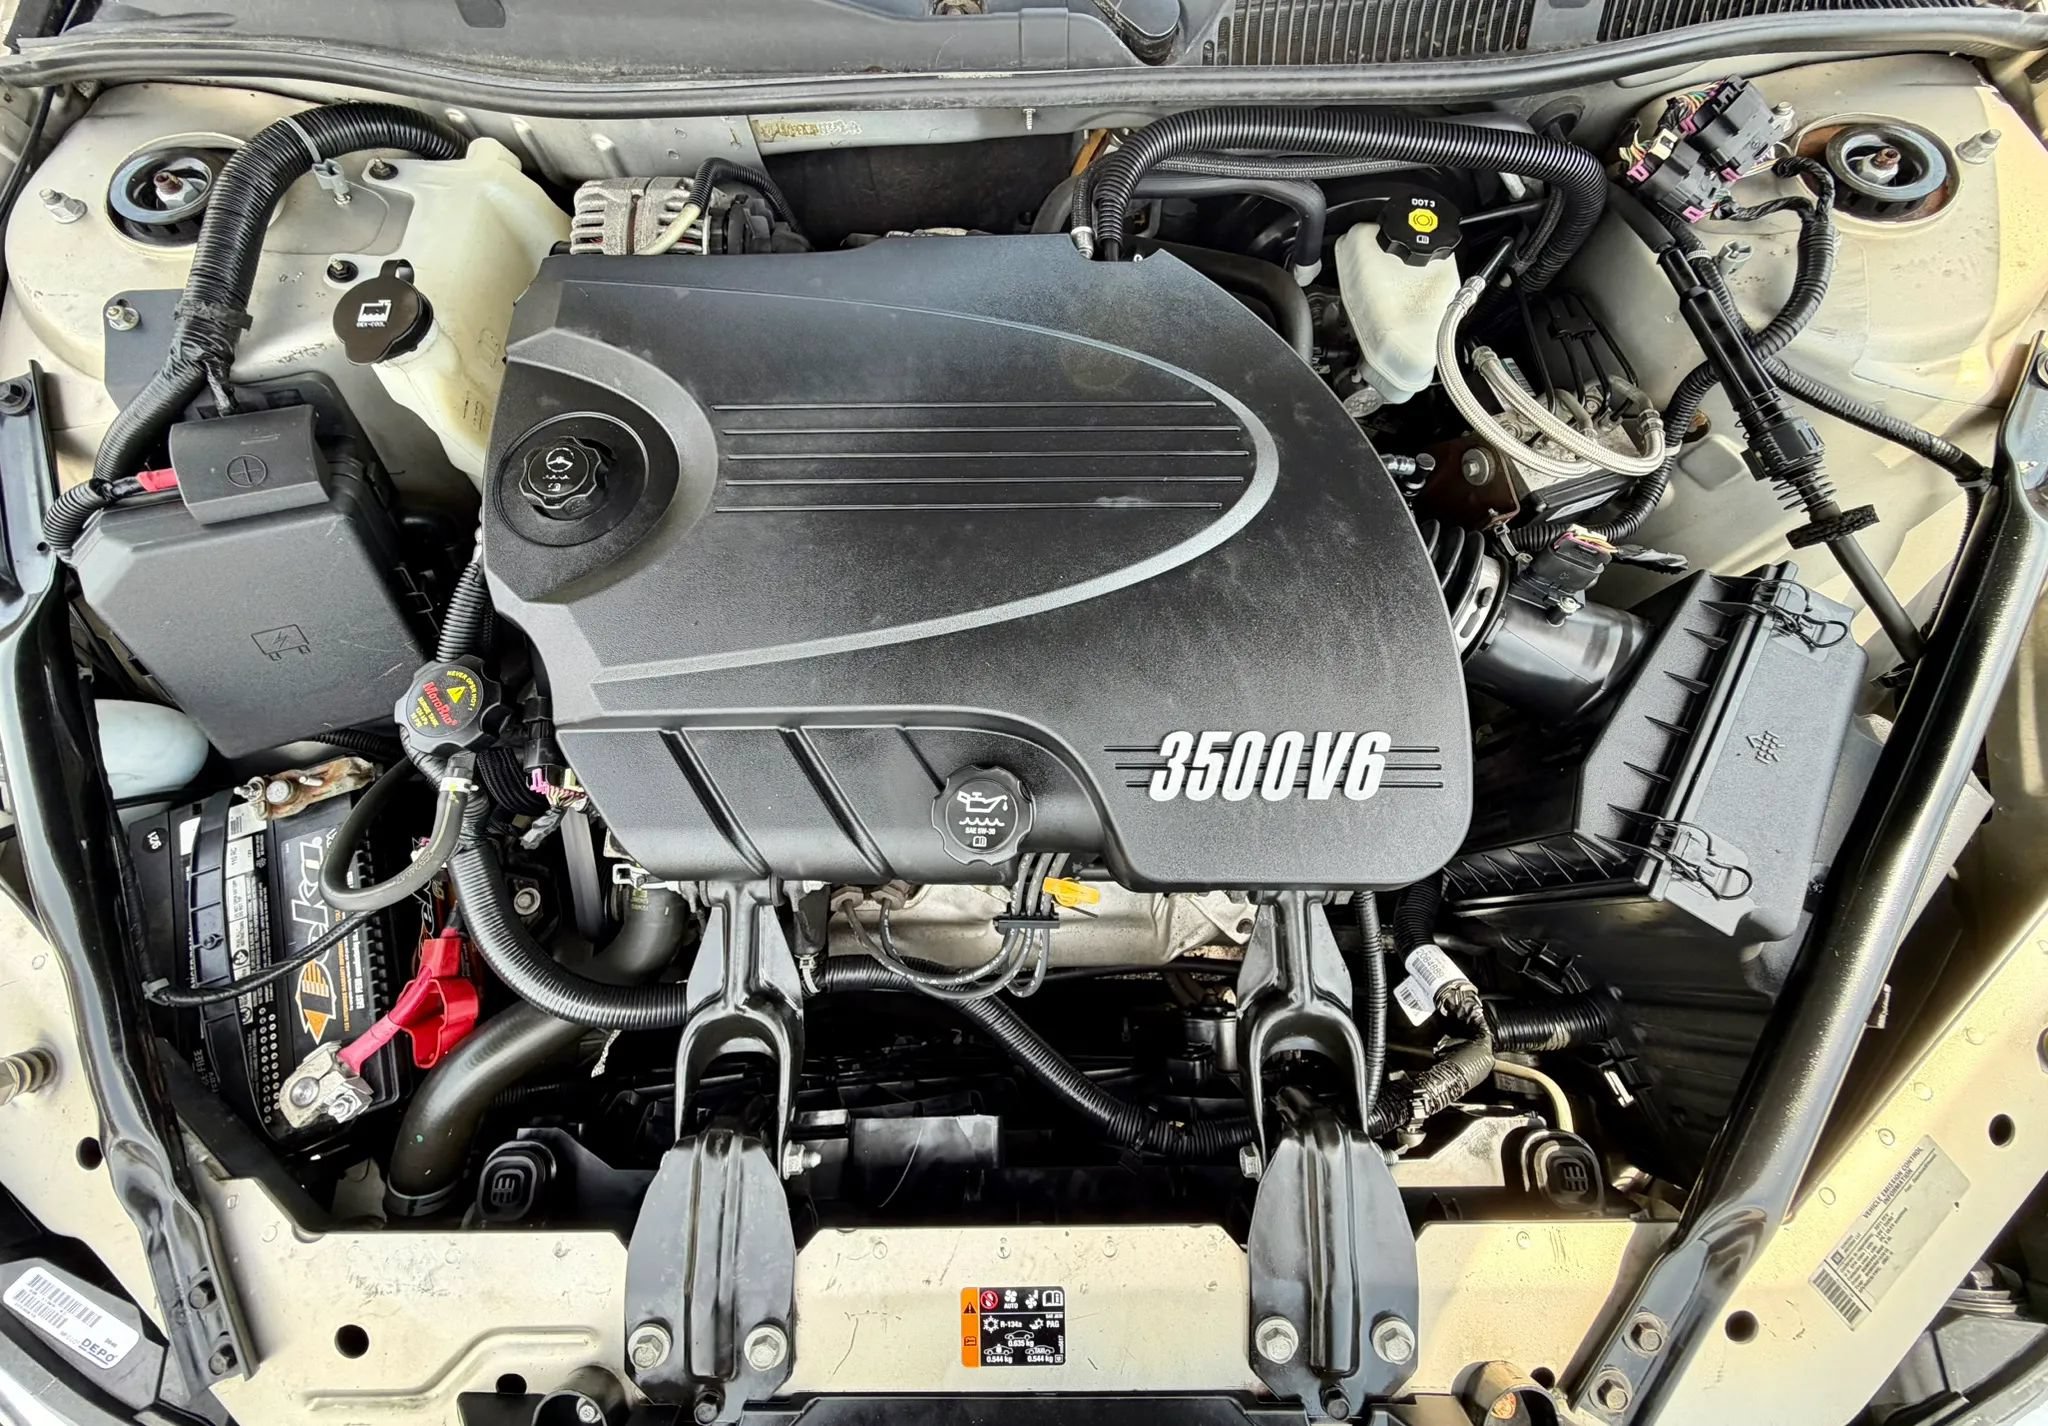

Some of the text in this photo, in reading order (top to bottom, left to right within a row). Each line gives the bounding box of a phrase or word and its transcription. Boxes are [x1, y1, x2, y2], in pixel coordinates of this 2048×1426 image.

[1411, 198, 1428, 206] DOT
[446, 670, 468, 680] NEVER
[466, 677, 477, 693] OPEN
[417, 696, 440, 728] SURGE TANK
[1862, 1196, 1882, 1219] VEHICLE
[1881, 1169, 1904, 1197] EMISSION
[1901, 1147, 1923, 1171] CONTROL
[1883, 1169, 1913, 1205] INFORMATION
[1046, 1320, 1060, 1328] PAG
[81, 1338, 115, 1362] DEPO
[1026, 1340, 1034, 1348] kg
[1004, 1356, 1013, 1364] kg
[1045, 1355, 1053, 1363] kg
